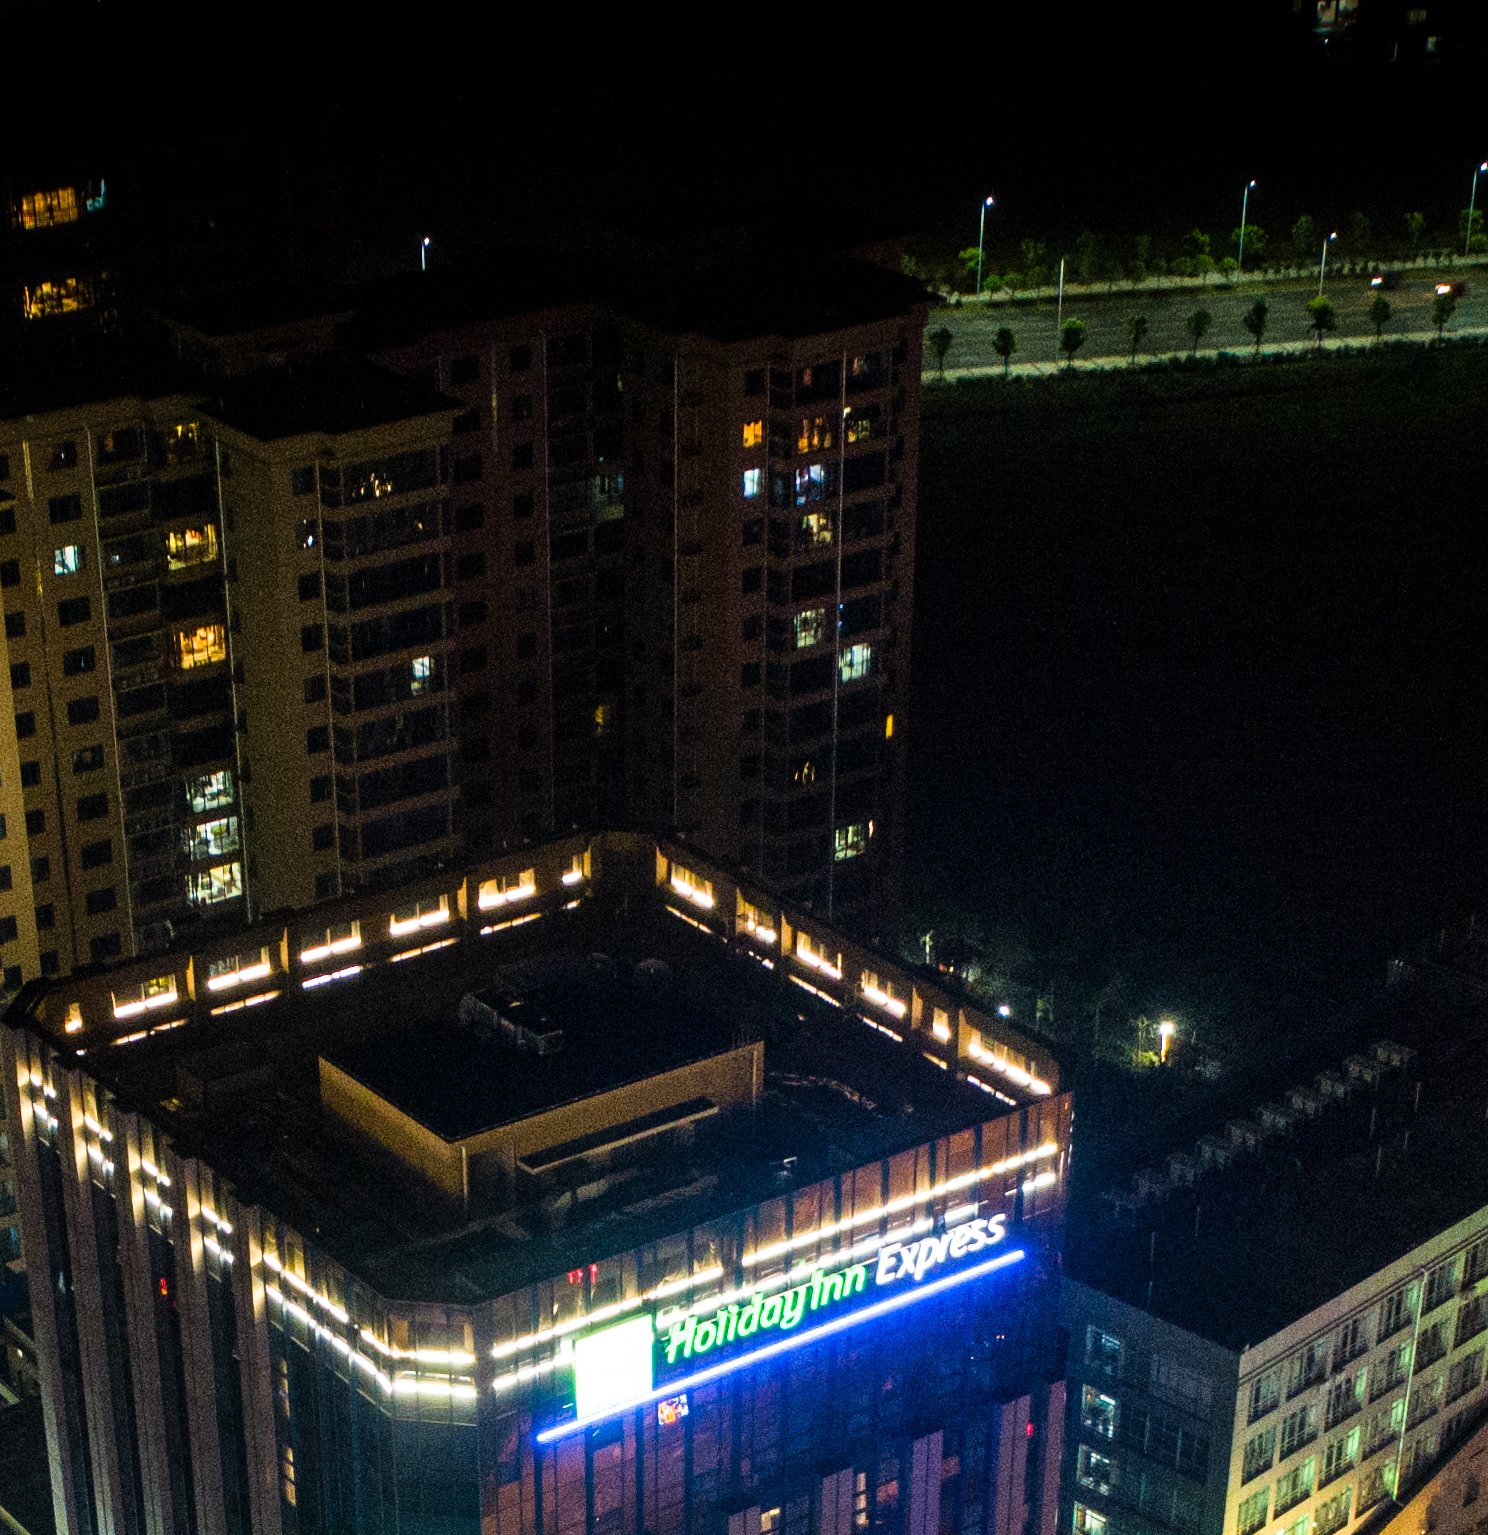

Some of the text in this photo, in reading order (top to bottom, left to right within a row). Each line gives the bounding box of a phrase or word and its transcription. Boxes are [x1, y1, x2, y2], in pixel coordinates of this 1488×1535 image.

[665, 1213, 1006, 1364] Holiday Inn Express
